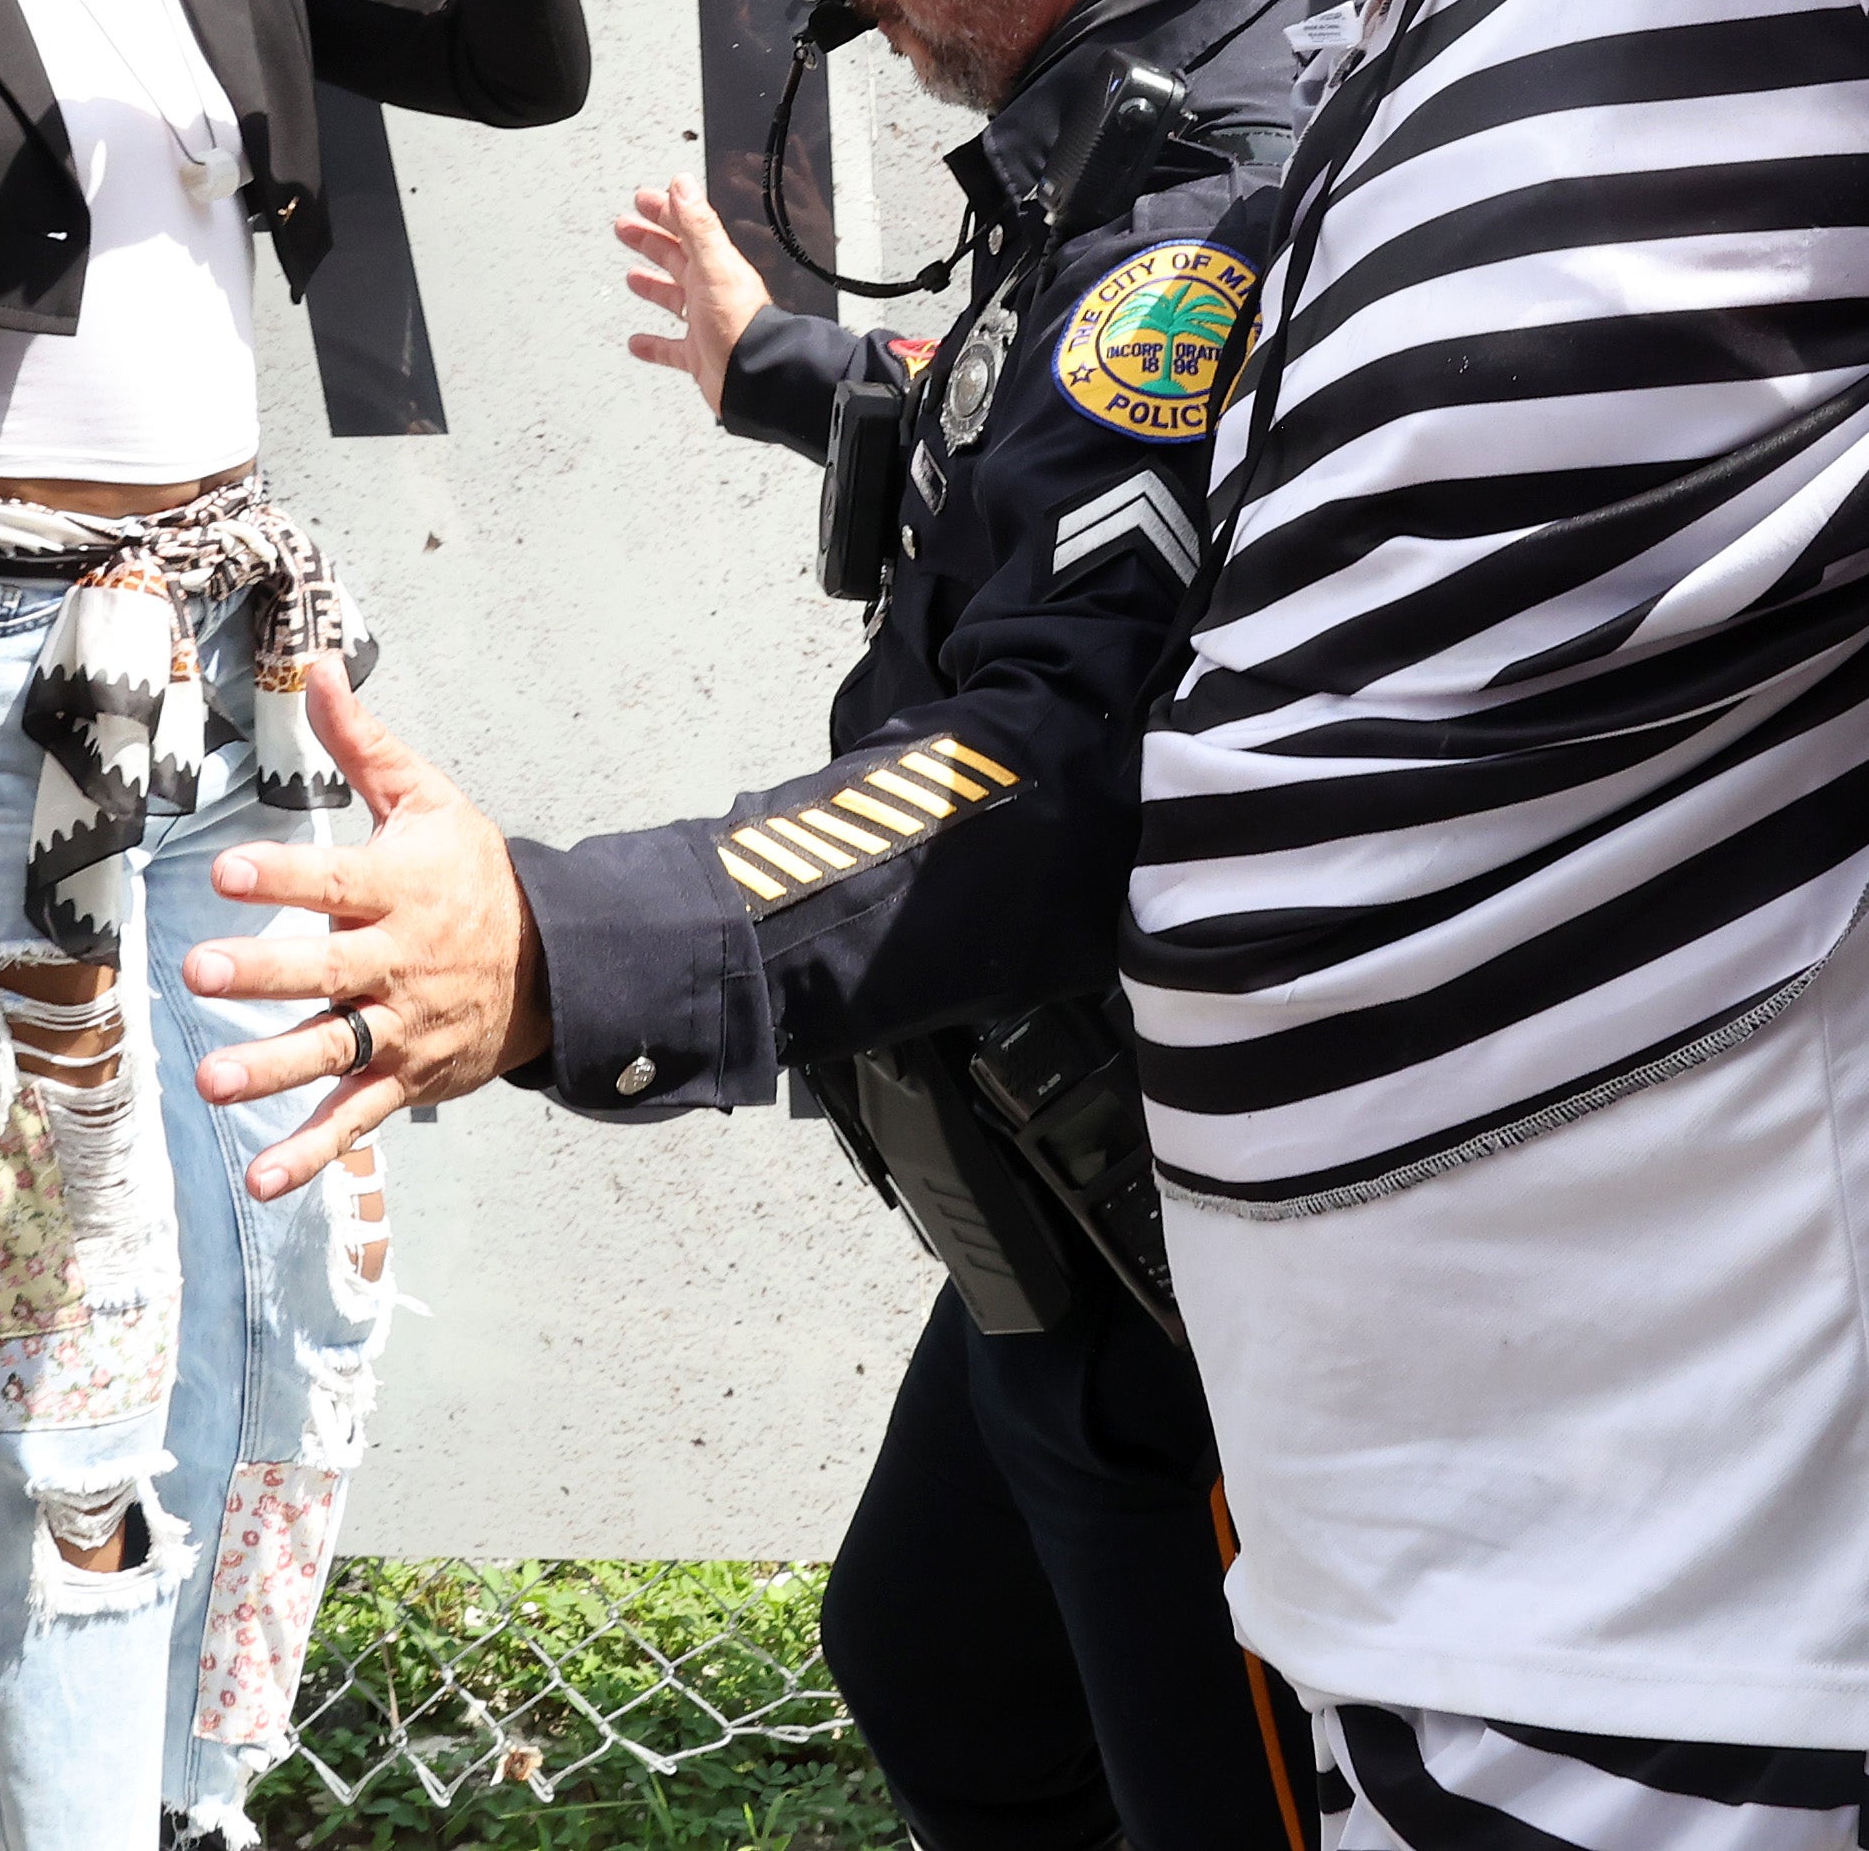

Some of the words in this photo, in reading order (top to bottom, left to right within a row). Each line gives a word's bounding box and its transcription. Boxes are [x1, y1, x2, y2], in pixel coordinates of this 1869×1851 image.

[1067, 308, 1103, 354] THE
[1098, 257, 1155, 303] CITY
[1172, 252, 1213, 277] OF
[1105, 392, 1210, 430] POLIC
